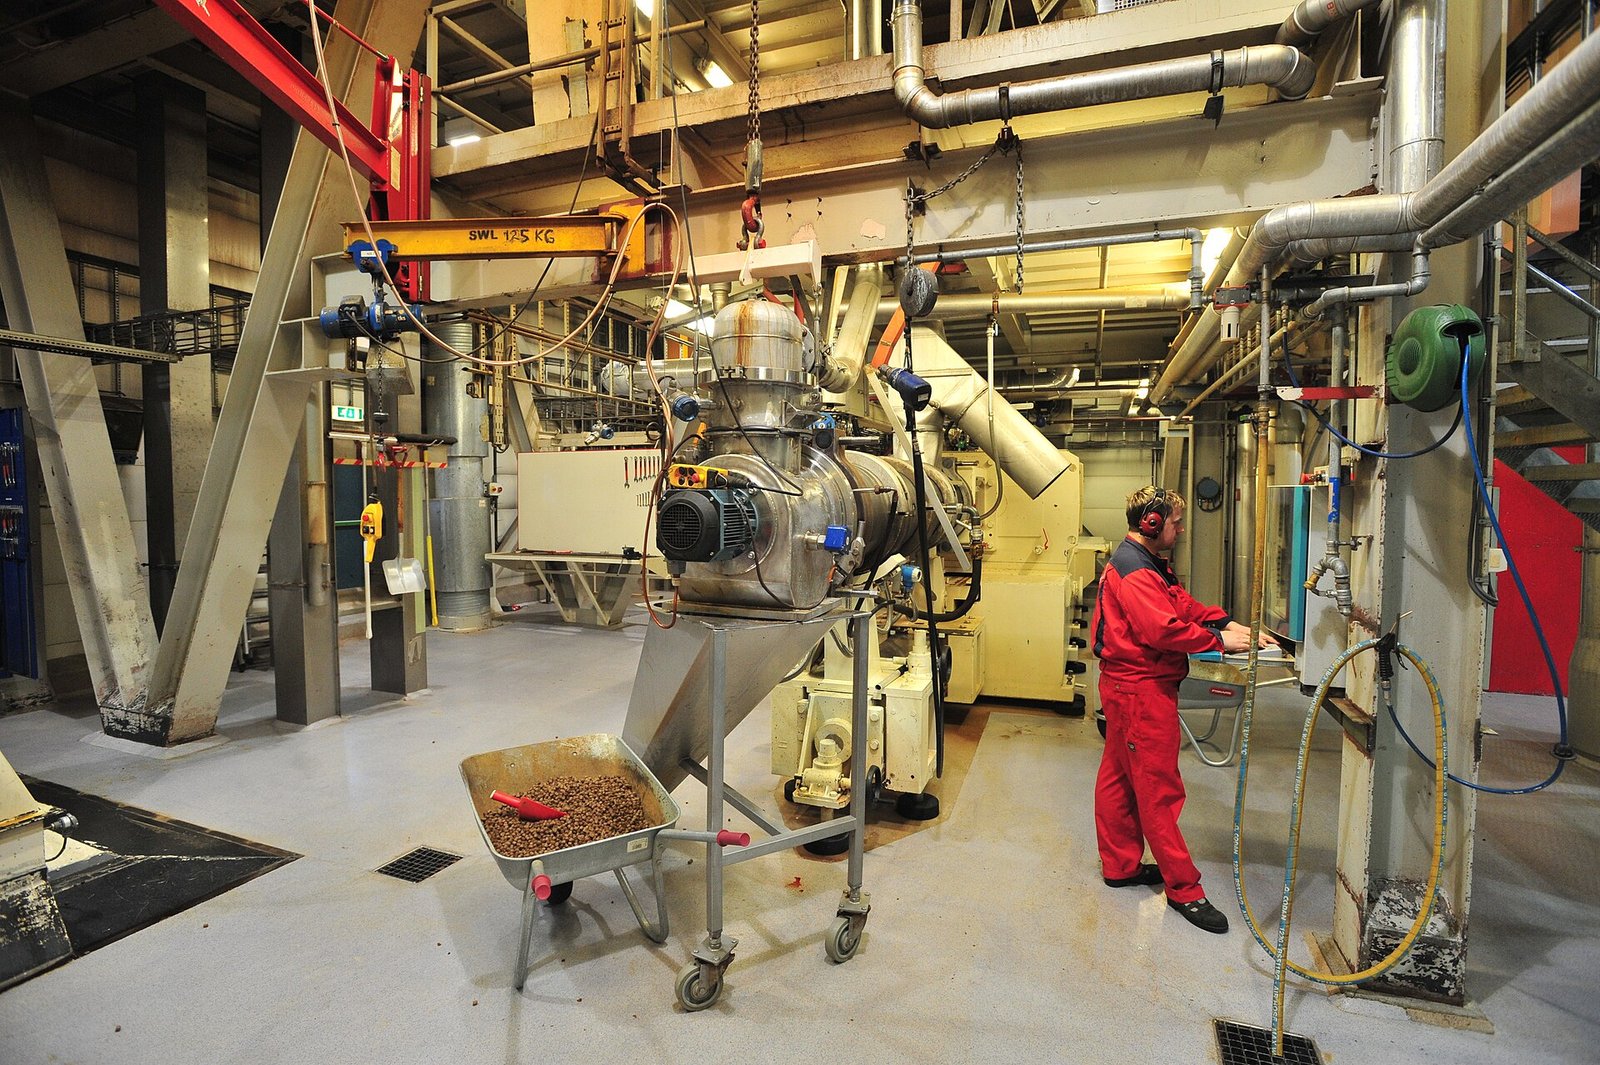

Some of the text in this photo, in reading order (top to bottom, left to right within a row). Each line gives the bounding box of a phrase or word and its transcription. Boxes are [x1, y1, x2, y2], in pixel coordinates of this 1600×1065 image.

[469, 229, 555, 244] SWL 125 KG
[1281, 896, 1289, 921] CODAN
